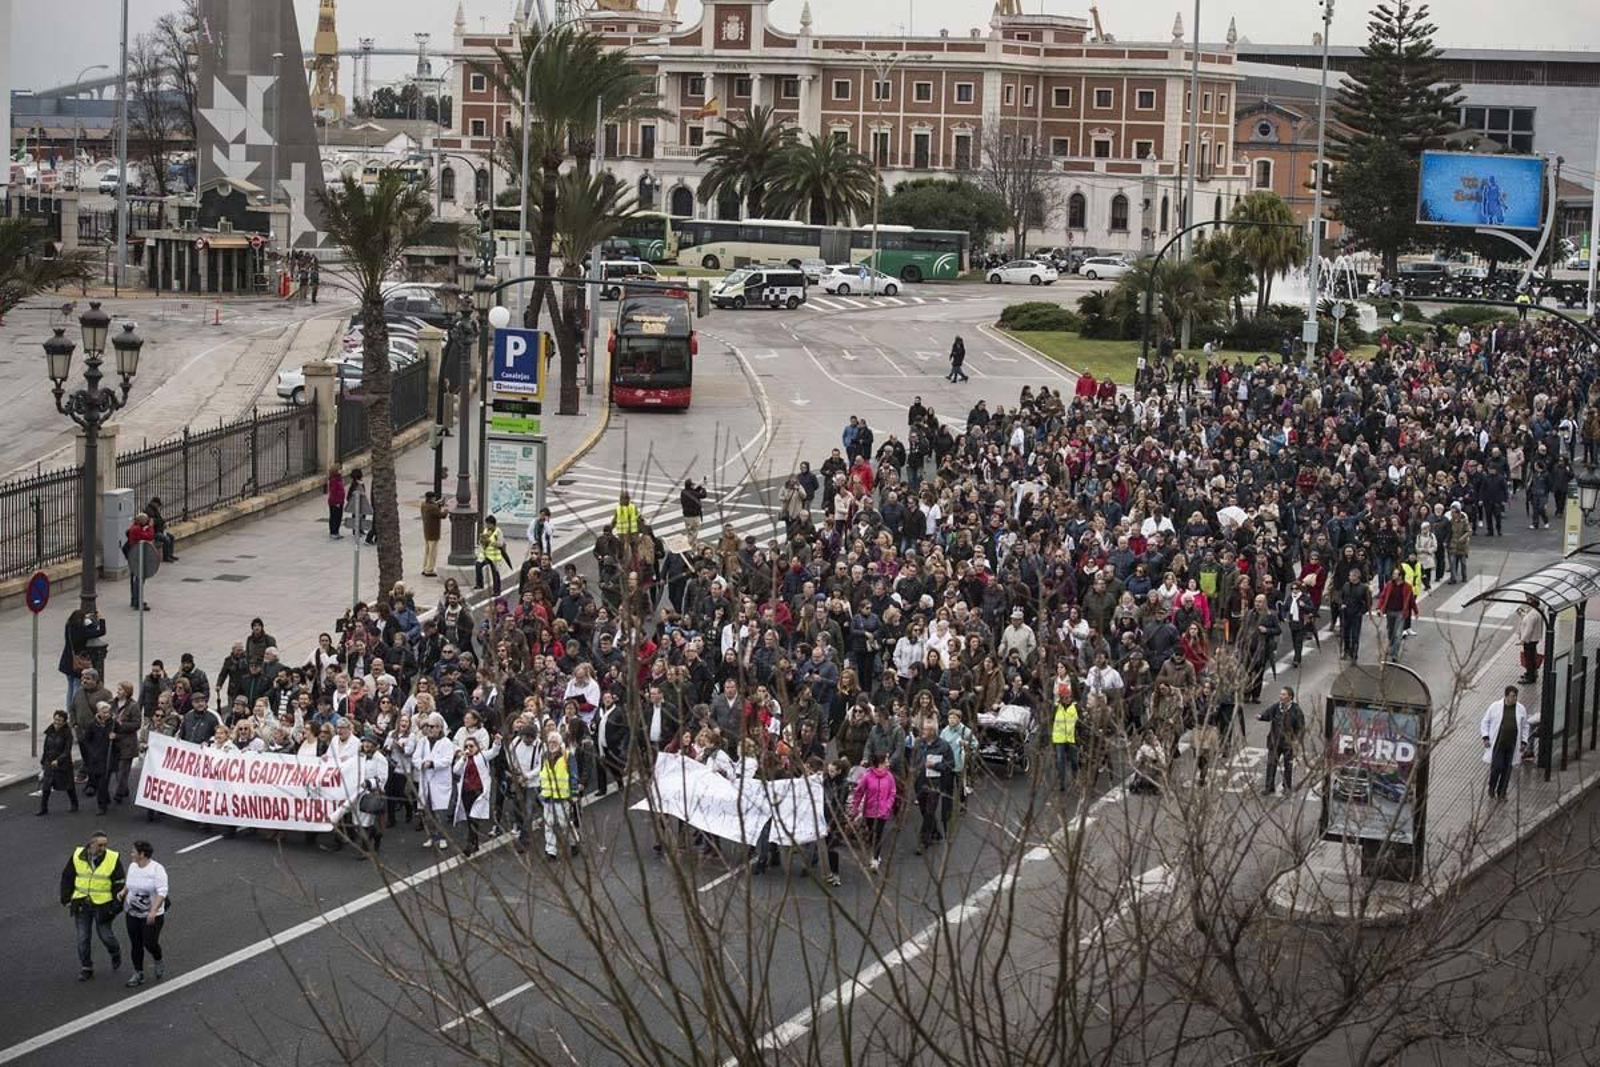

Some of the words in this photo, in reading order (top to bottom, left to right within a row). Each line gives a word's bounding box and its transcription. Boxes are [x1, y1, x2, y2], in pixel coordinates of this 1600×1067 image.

[505, 335, 527, 368] P
[1338, 734, 1415, 762] FORD
[249, 760, 321, 787] GADITANA
[321, 767, 342, 788] EN
[143, 775, 197, 812] DEFENSA
[198, 789, 212, 814] DE
[214, 792, 229, 816] LA
[232, 794, 290, 821] SANIDAD
